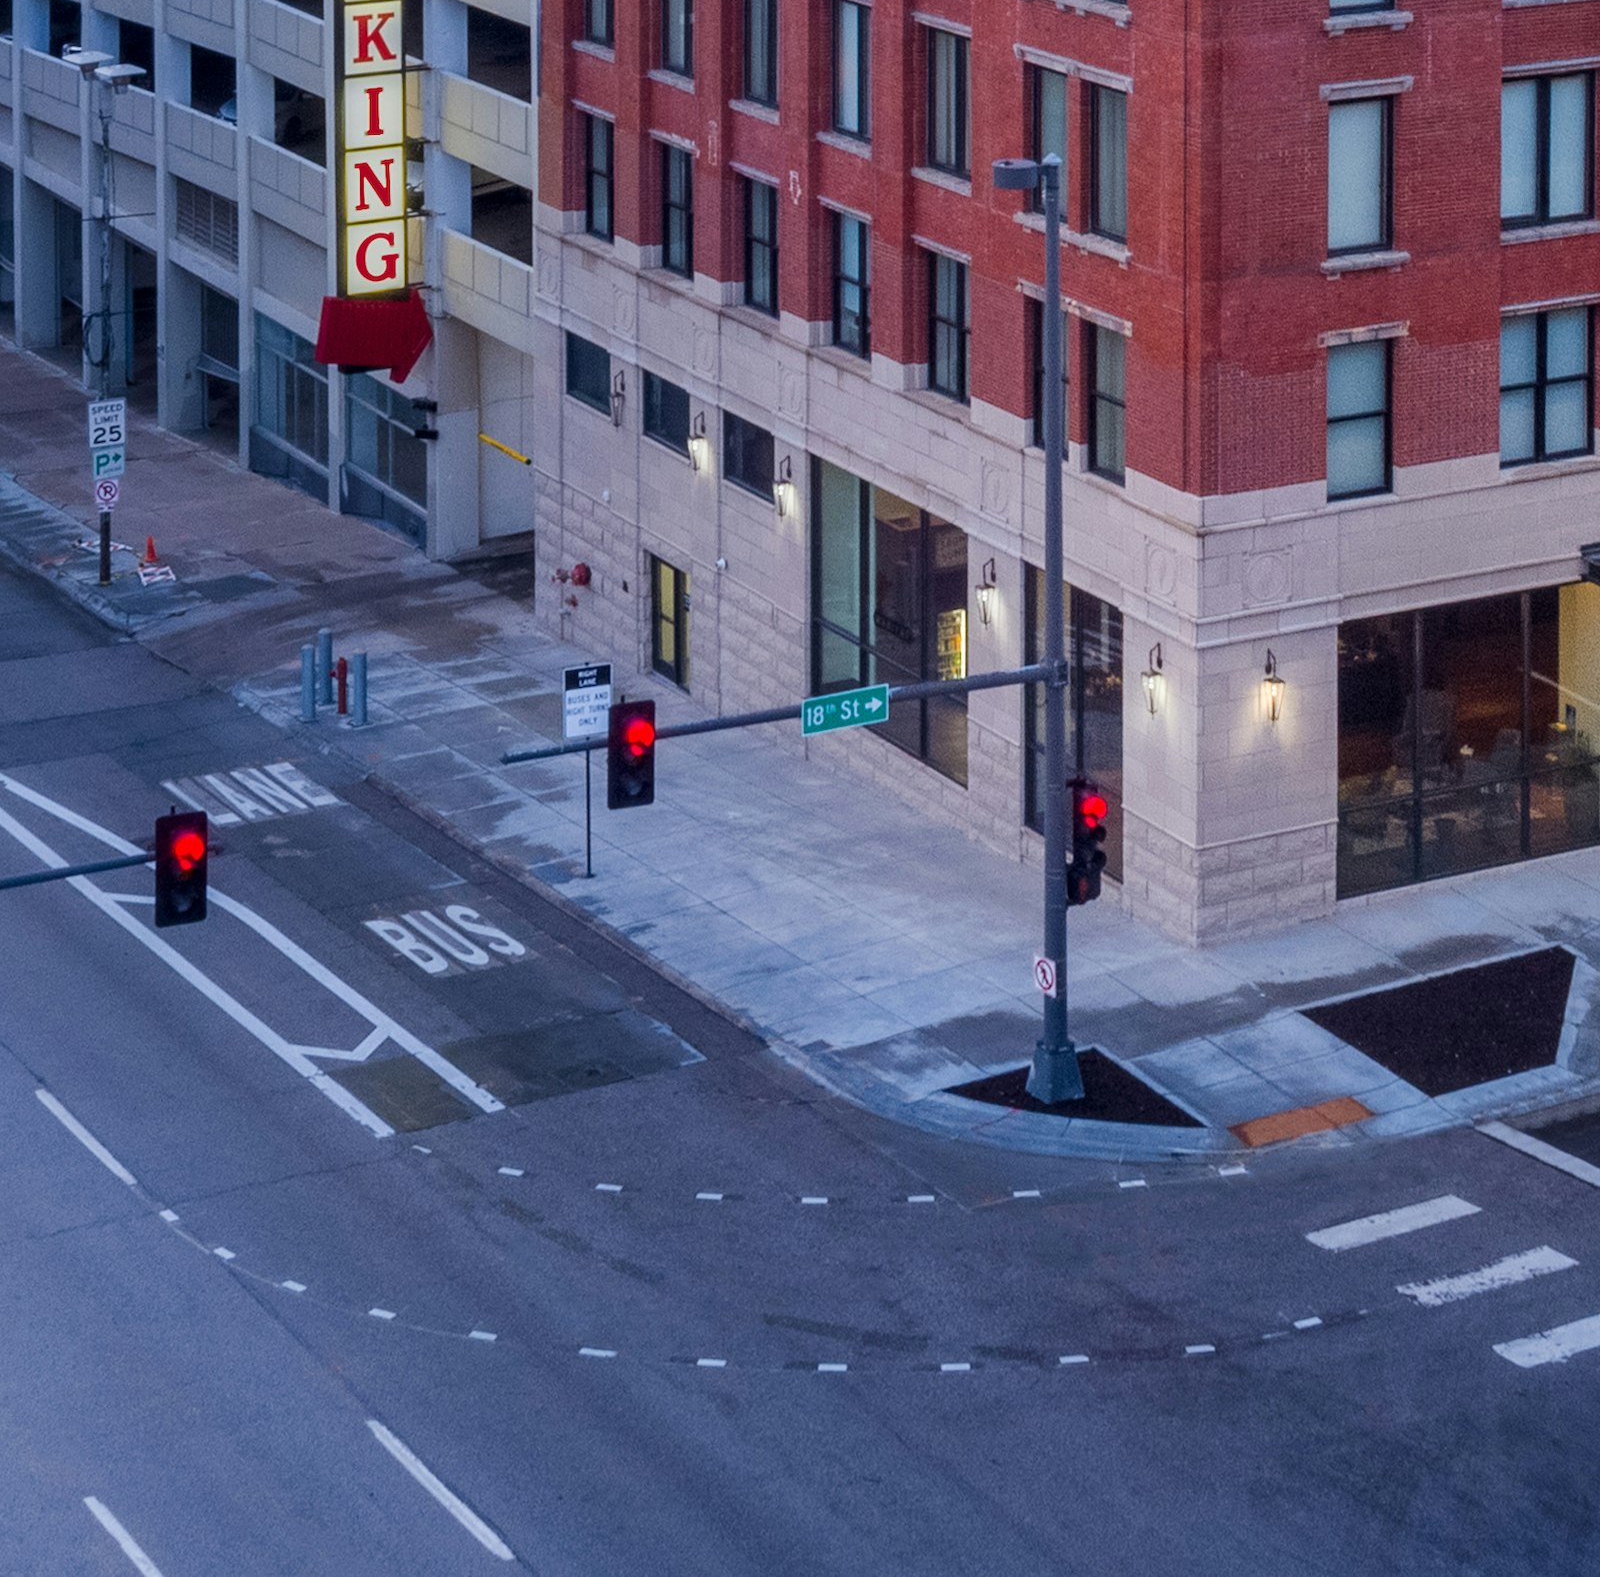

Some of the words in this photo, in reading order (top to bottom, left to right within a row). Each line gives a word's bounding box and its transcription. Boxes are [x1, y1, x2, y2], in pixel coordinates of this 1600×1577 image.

[91, 405, 123, 415] SPEED
[94, 415, 120, 425] LIMIT
[93, 425, 122, 445] 25
[96, 454, 110, 475] P
[578, 669, 598, 678] RIGHT
[579, 678, 597, 687] LANE
[567, 694, 591, 704] BUSES
[595, 691, 609, 700] AND
[840, 698, 859, 720] St
[578, 717, 598, 727] ONLY
[159, 761, 342, 824] LANE
[363, 904, 526, 975] BUS
